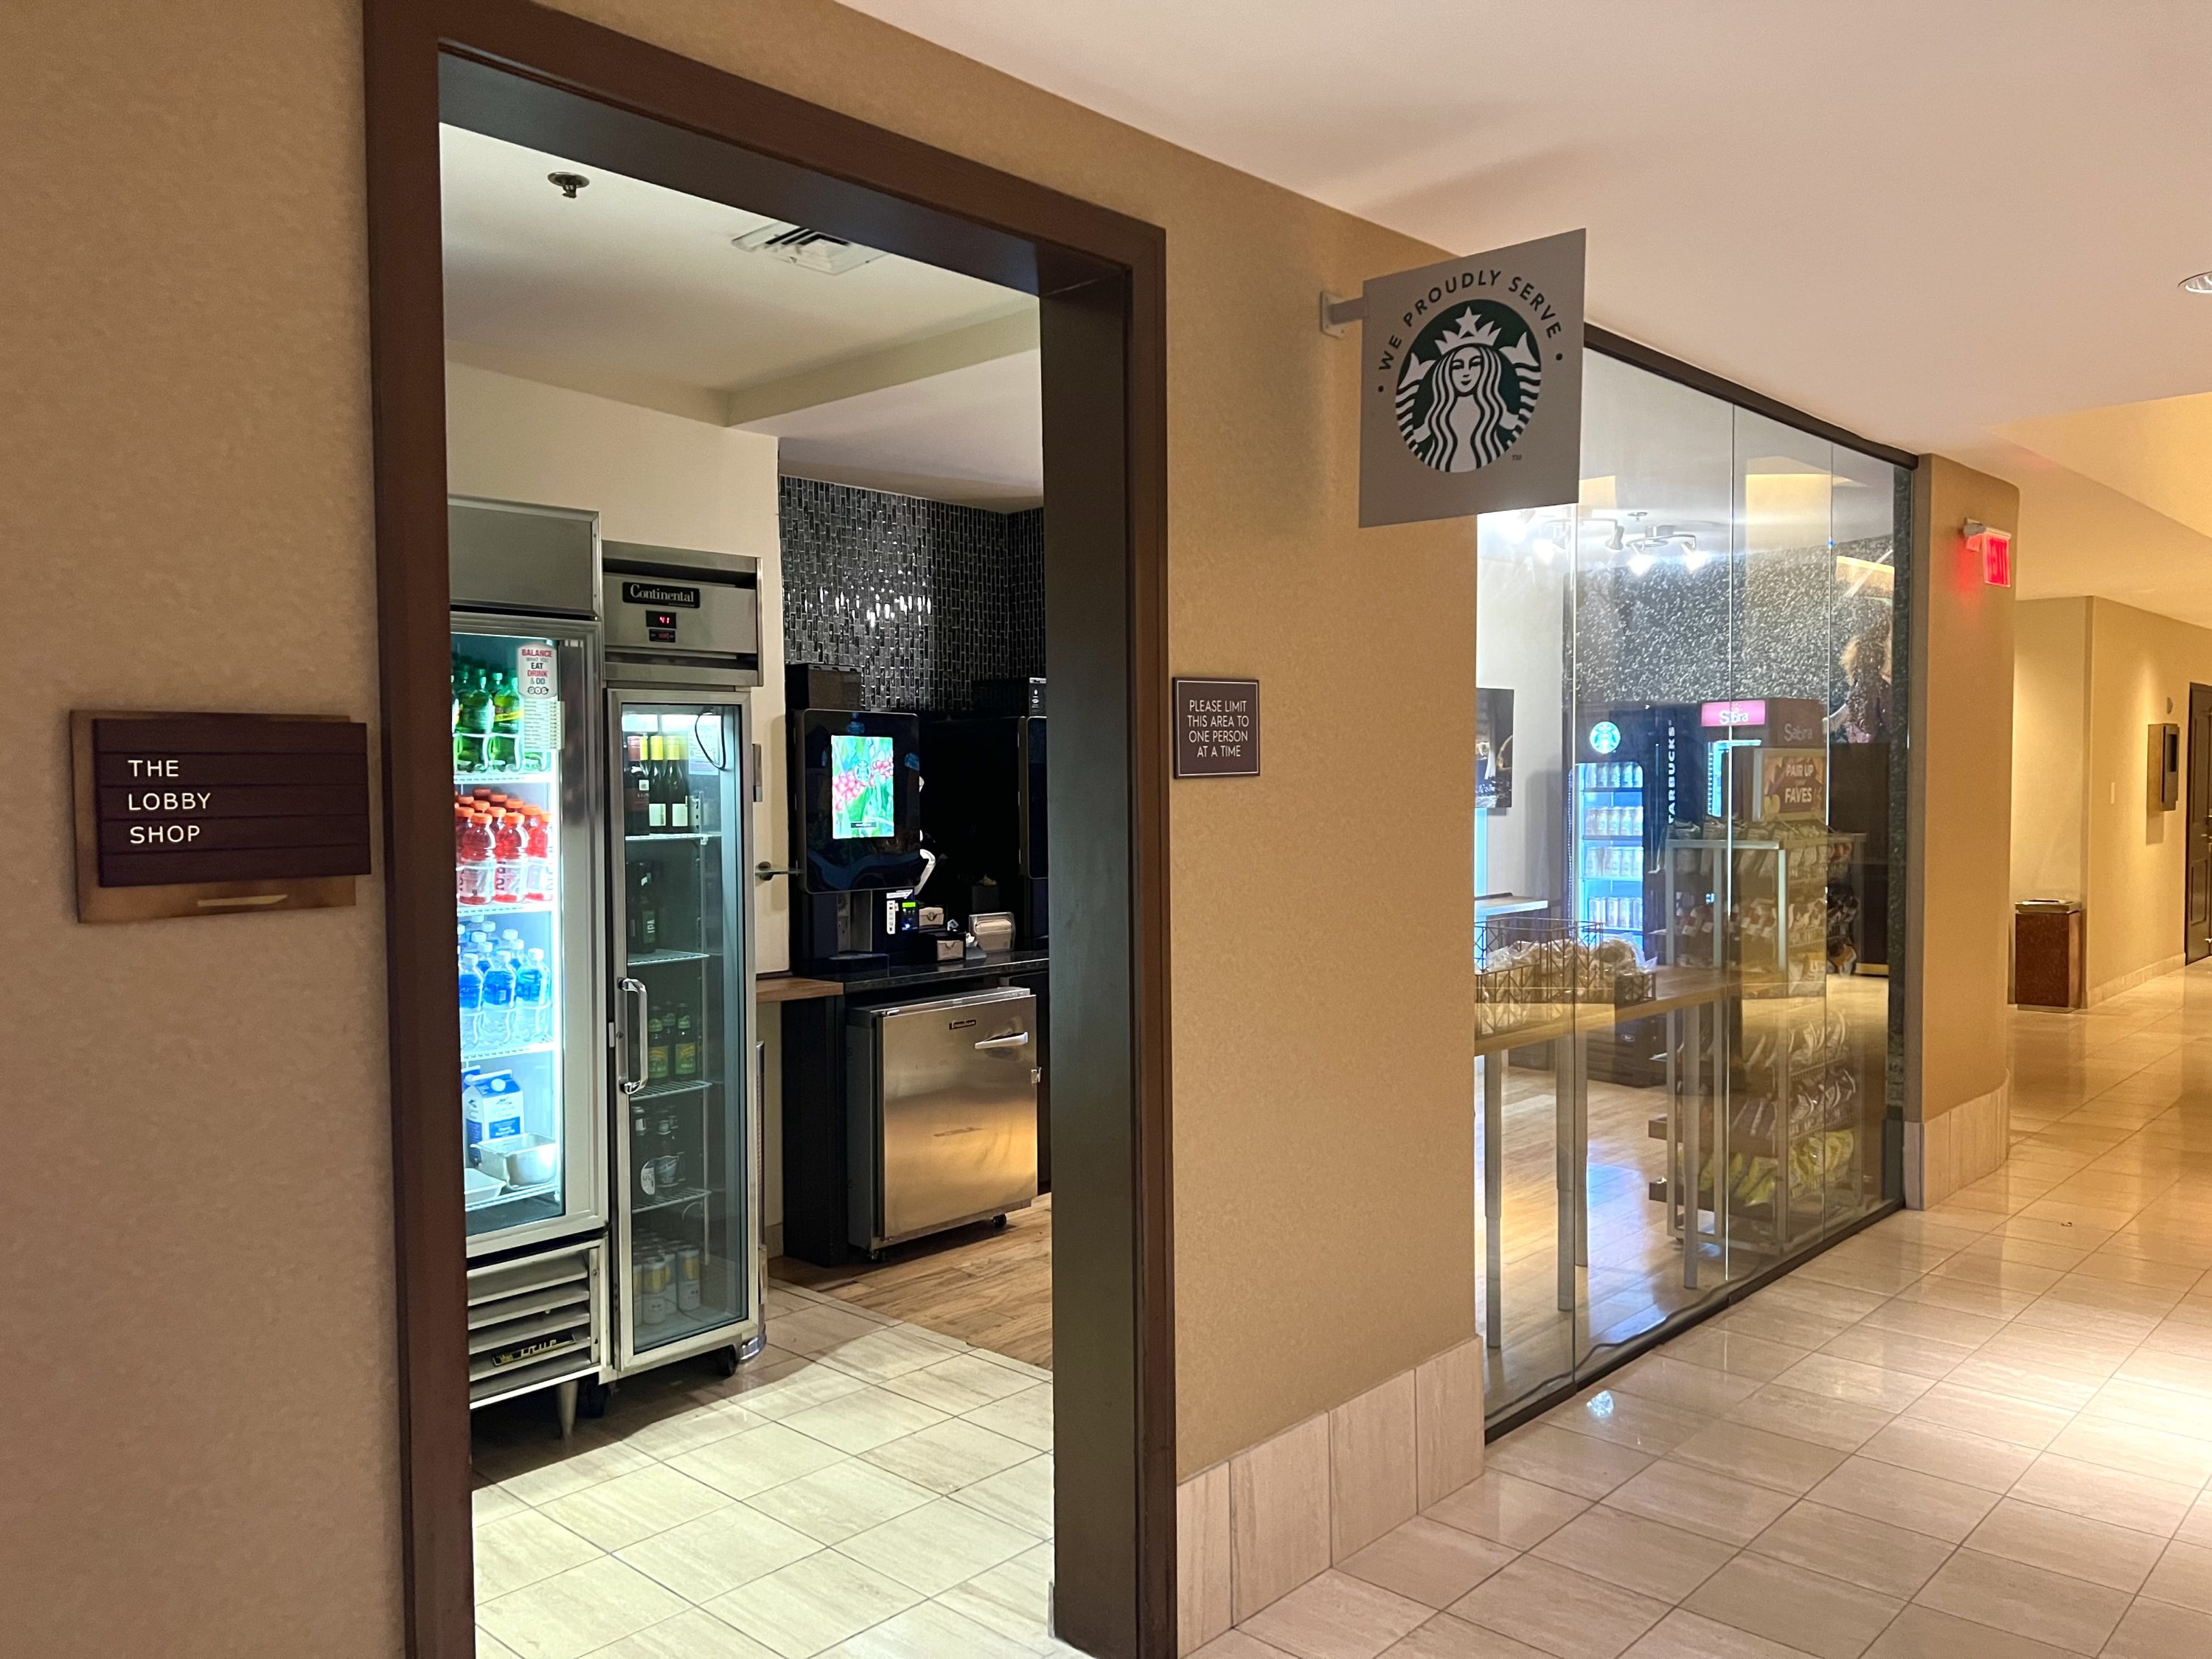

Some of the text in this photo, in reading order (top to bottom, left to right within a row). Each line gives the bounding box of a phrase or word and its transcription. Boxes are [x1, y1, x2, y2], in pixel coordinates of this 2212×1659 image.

[1378, 270, 1562, 371] WE PROUDLY SERVE
[630, 583, 695, 602] Continental
[522, 649, 553, 658] BALANCE
[527, 669, 548, 678] DRINK
[1189, 700, 1247, 712] PLEASE LIMIT
[1187, 715, 1250, 727] THIS AREA TO
[1189, 730, 1248, 742] ONE PERSON
[1197, 745, 1241, 757] AT A TIME
[128, 759, 179, 777] THE
[1668, 726, 1676, 824] TARBUCKS
[1786, 764, 1814, 777] PAIR UP
[128, 792, 211, 810] LOBBY
[1784, 787, 1812, 804] FAVES
[130, 825, 201, 844] SHOP
[647, 919, 655, 933] IPA
